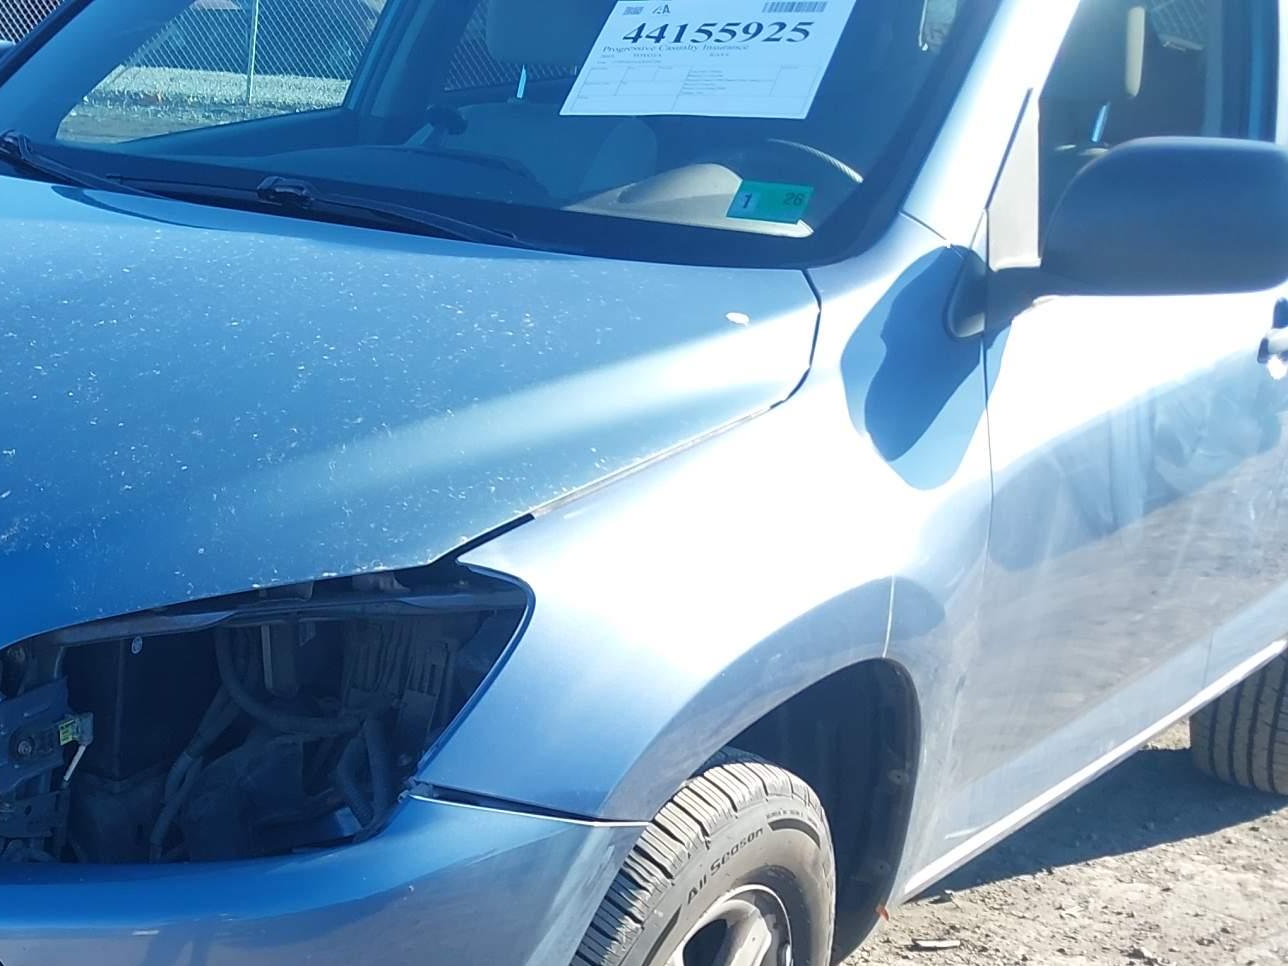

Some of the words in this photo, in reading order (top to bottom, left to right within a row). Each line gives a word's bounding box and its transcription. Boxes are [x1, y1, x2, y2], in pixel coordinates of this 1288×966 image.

[622, 21, 814, 44] 44155925
[743, 193, 753, 208] 1
[783, 191, 805, 207] 26
